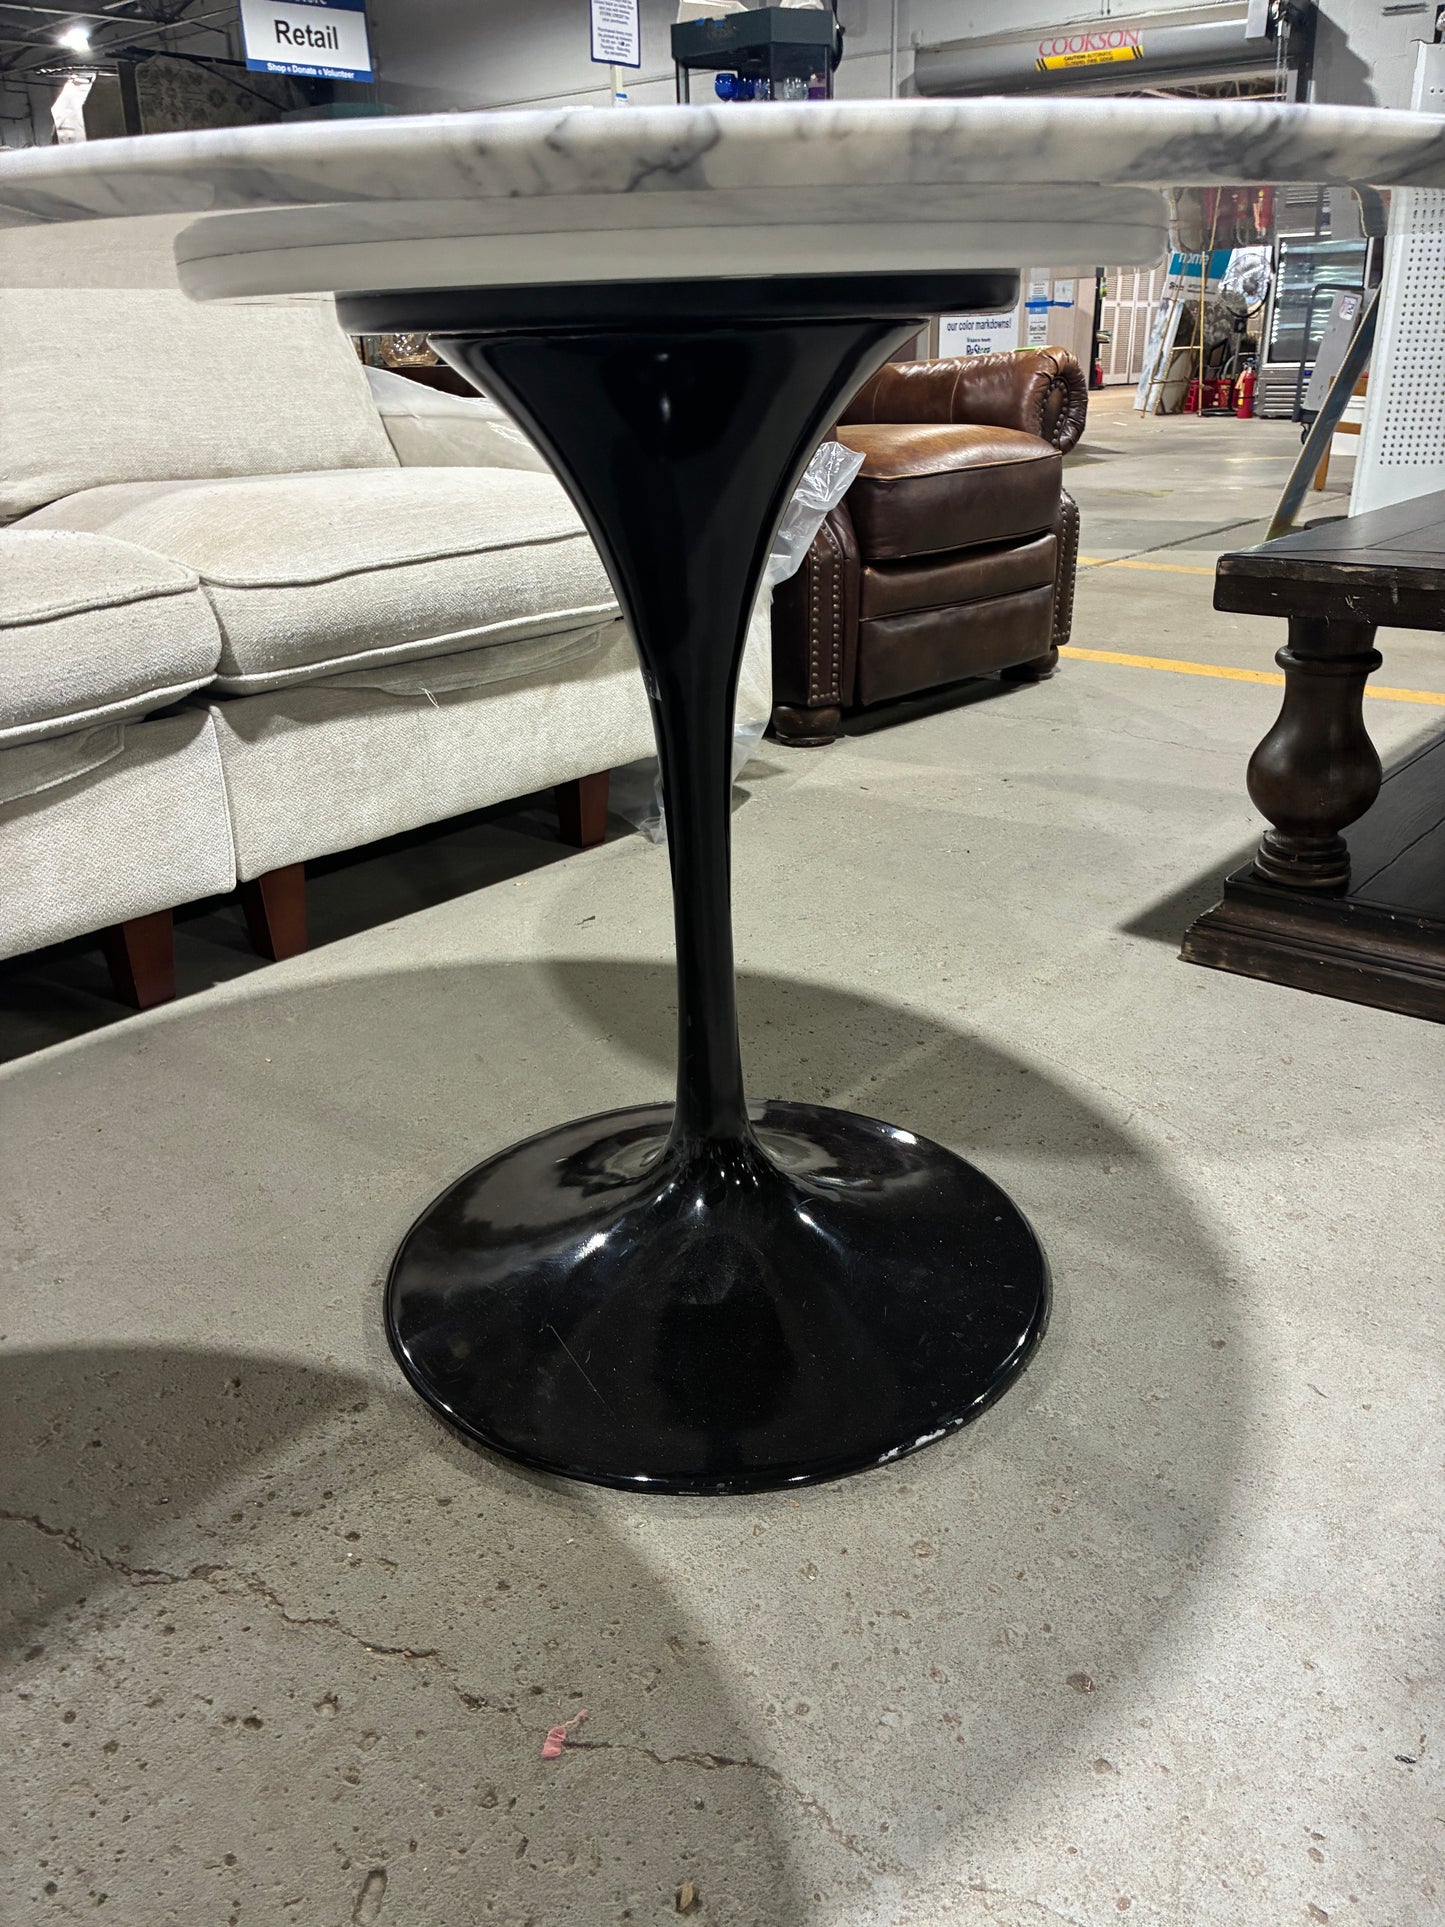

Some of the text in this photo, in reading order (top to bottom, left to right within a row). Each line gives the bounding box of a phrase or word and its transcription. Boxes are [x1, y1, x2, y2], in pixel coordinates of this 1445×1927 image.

[274, 19, 339, 50] Retail
[1038, 29, 1140, 57] COOKSON
[267, 62, 355, 79] Shop Donate Volunteer
[947, 318, 1011, 331] our color markdowns!
